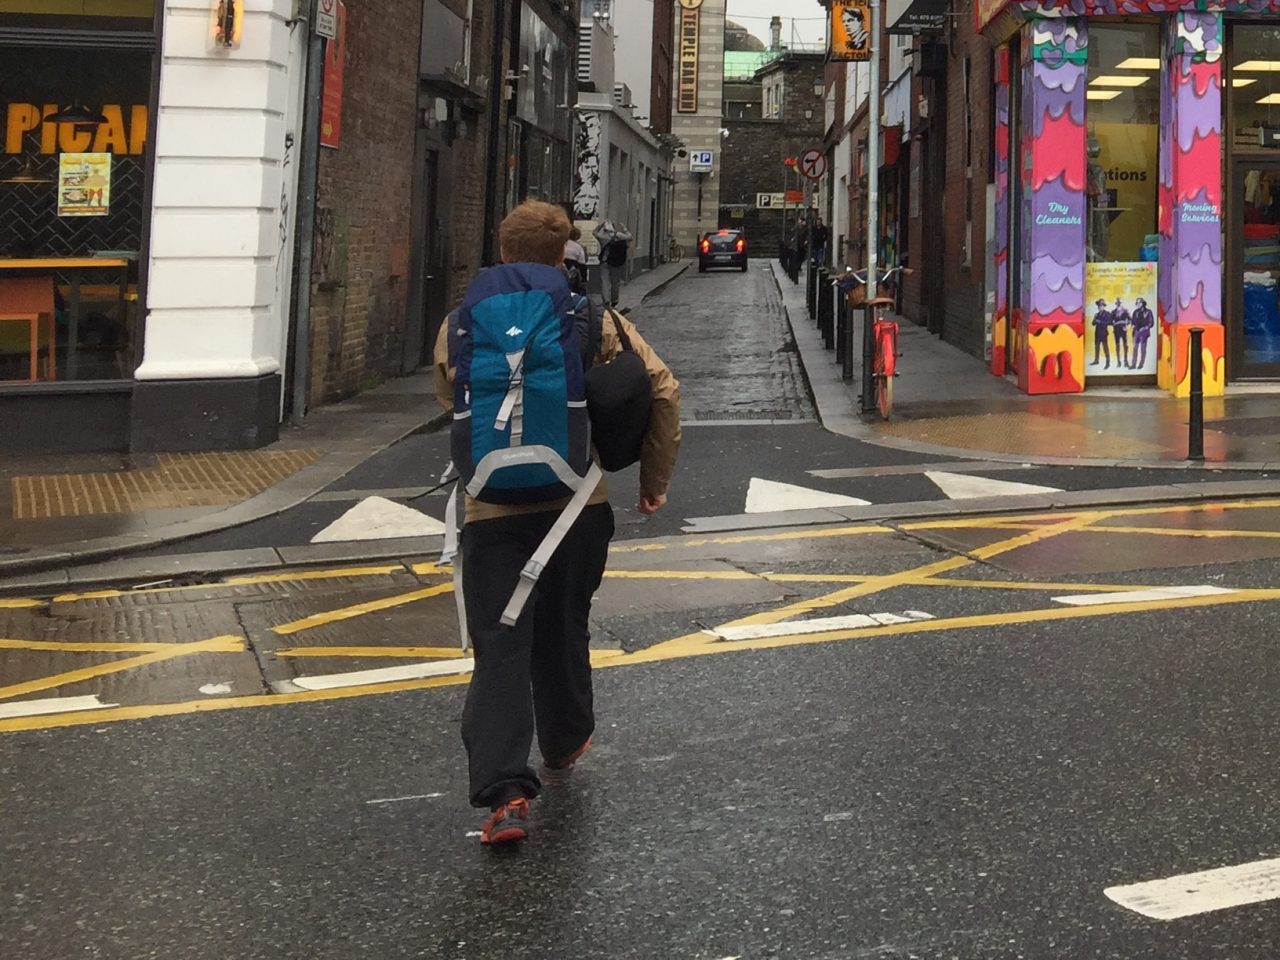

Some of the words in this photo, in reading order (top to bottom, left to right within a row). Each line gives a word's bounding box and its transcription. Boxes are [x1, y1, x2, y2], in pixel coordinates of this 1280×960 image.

[682, 12, 697, 58] TEMPLE
[681, 60, 696, 85] BAR
[680, 88, 695, 110] INN
[1048, 202, 1070, 214] Dry
[1036, 214, 1082, 225] Cleaners
